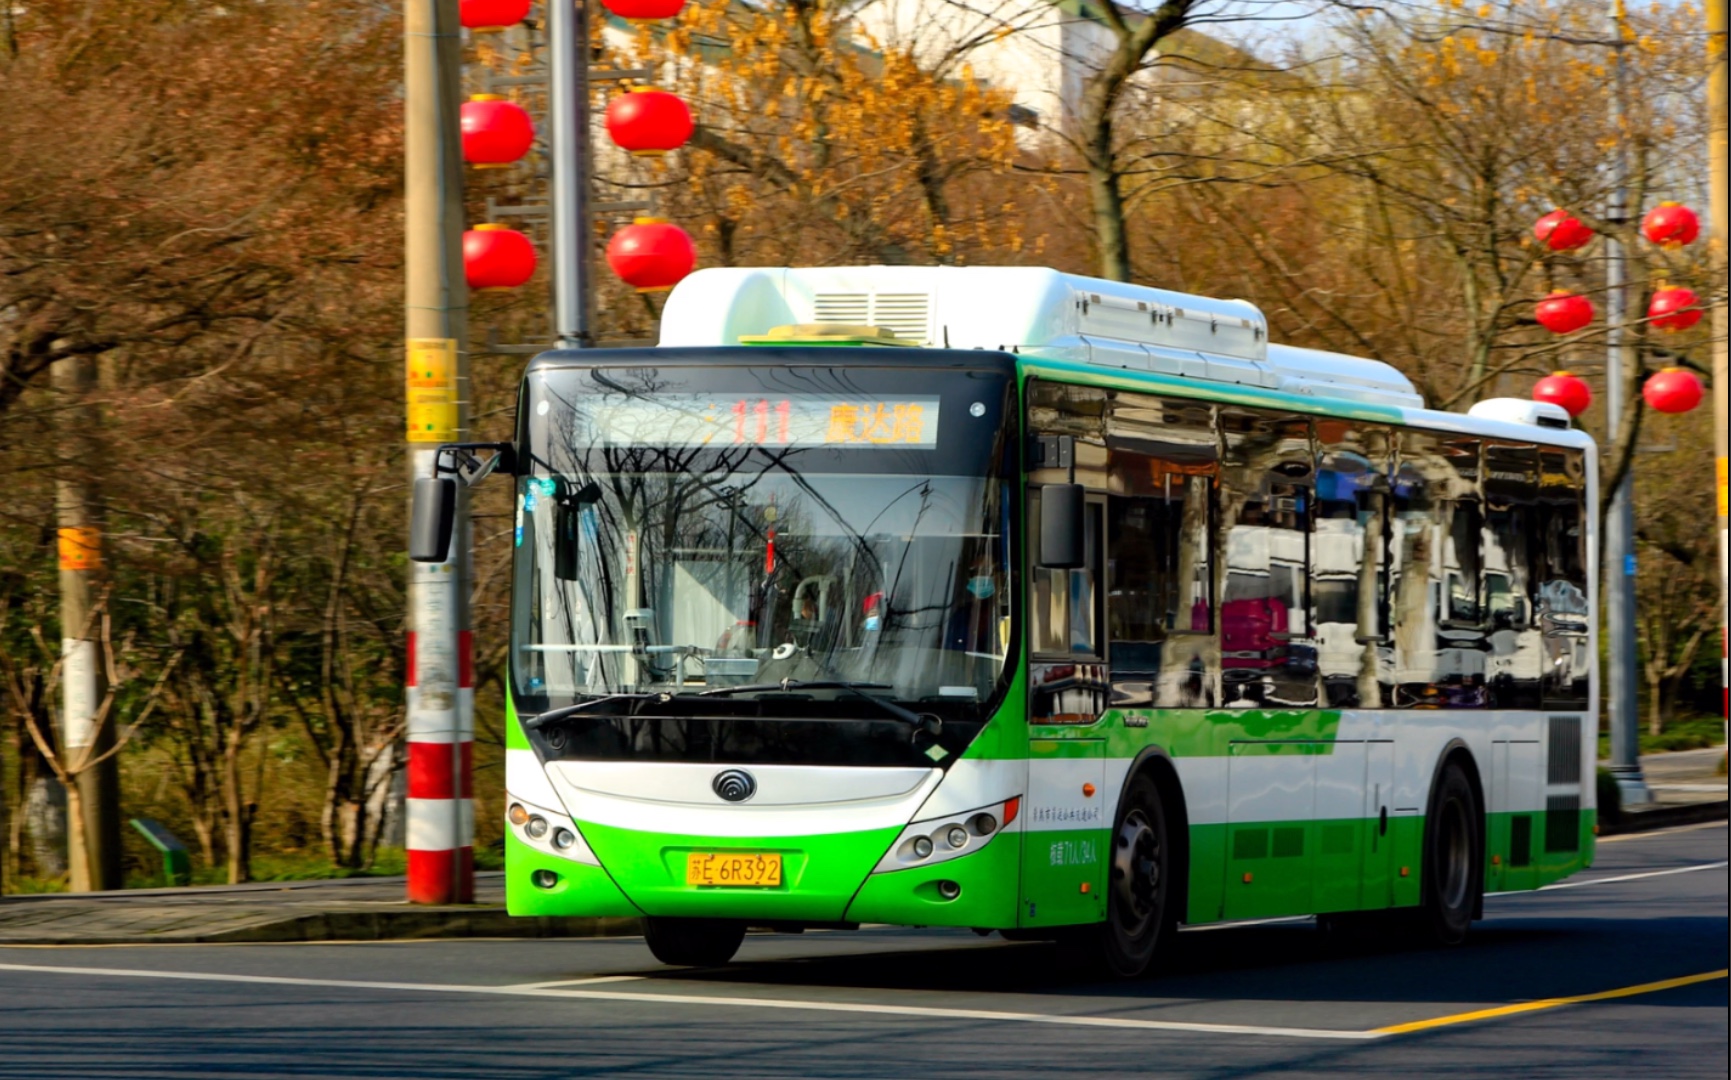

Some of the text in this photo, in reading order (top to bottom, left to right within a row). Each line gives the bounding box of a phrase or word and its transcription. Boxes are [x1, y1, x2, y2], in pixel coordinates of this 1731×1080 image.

[731, 400, 791, 443] 111
[825, 402, 924, 443] 康达路
